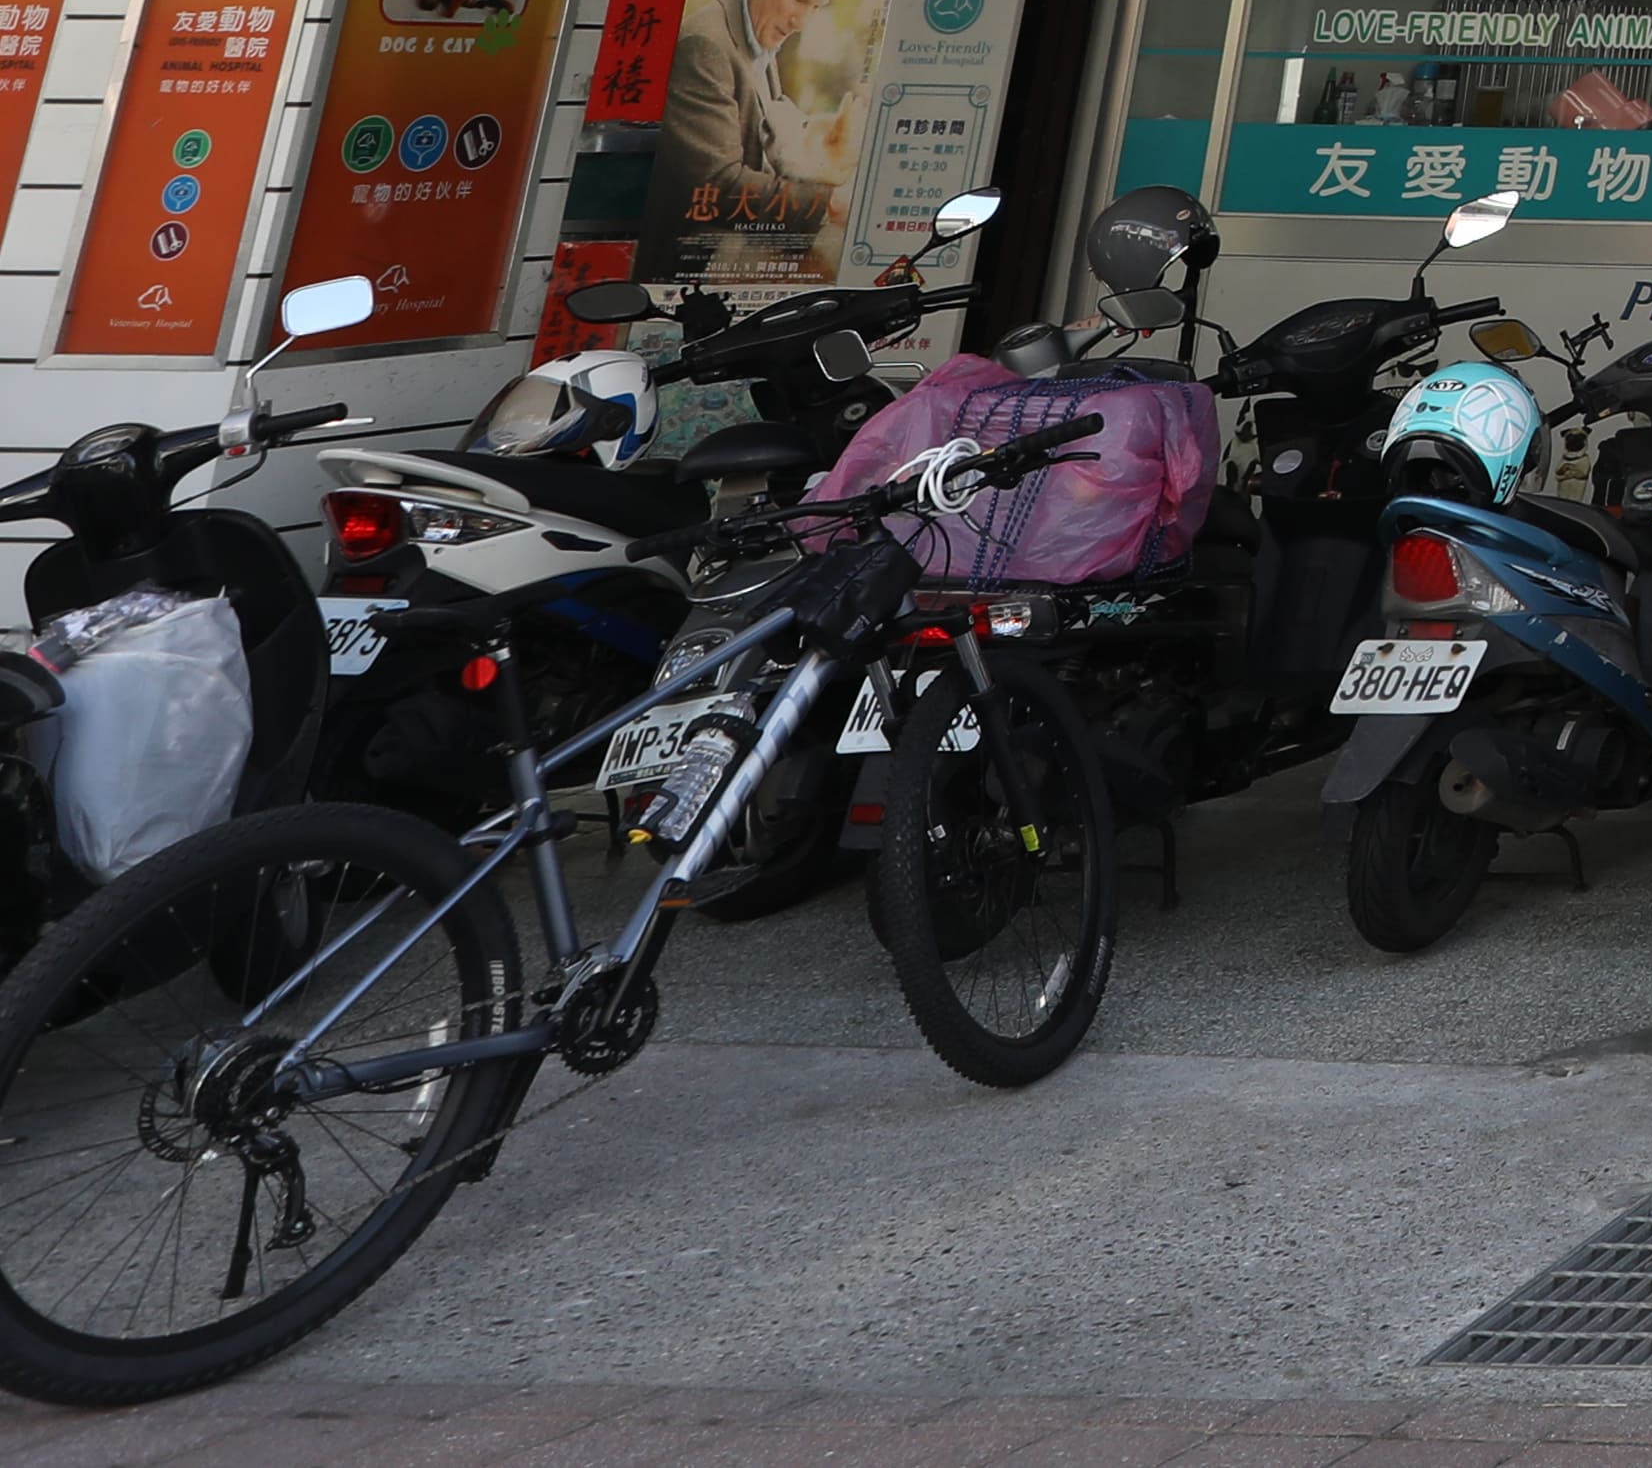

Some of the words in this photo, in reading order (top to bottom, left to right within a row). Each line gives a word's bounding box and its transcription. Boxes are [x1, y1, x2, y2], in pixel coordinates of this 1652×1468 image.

[172, 4, 276, 33] 友愛動物
[1312, 9, 1560, 46] LOVE-FRIENDLY
[223, 36, 269, 58] 醫院
[379, 36, 417, 54] DOG
[443, 36, 476, 54] CAT
[898, 39, 993, 55] Love-Friendly
[896, 118, 966, 135] 門診時間
[685, 182, 842, 223] 忠犬小八
[734, 222, 787, 231] HACHIKO
[395, 295, 445, 312] Hospital
